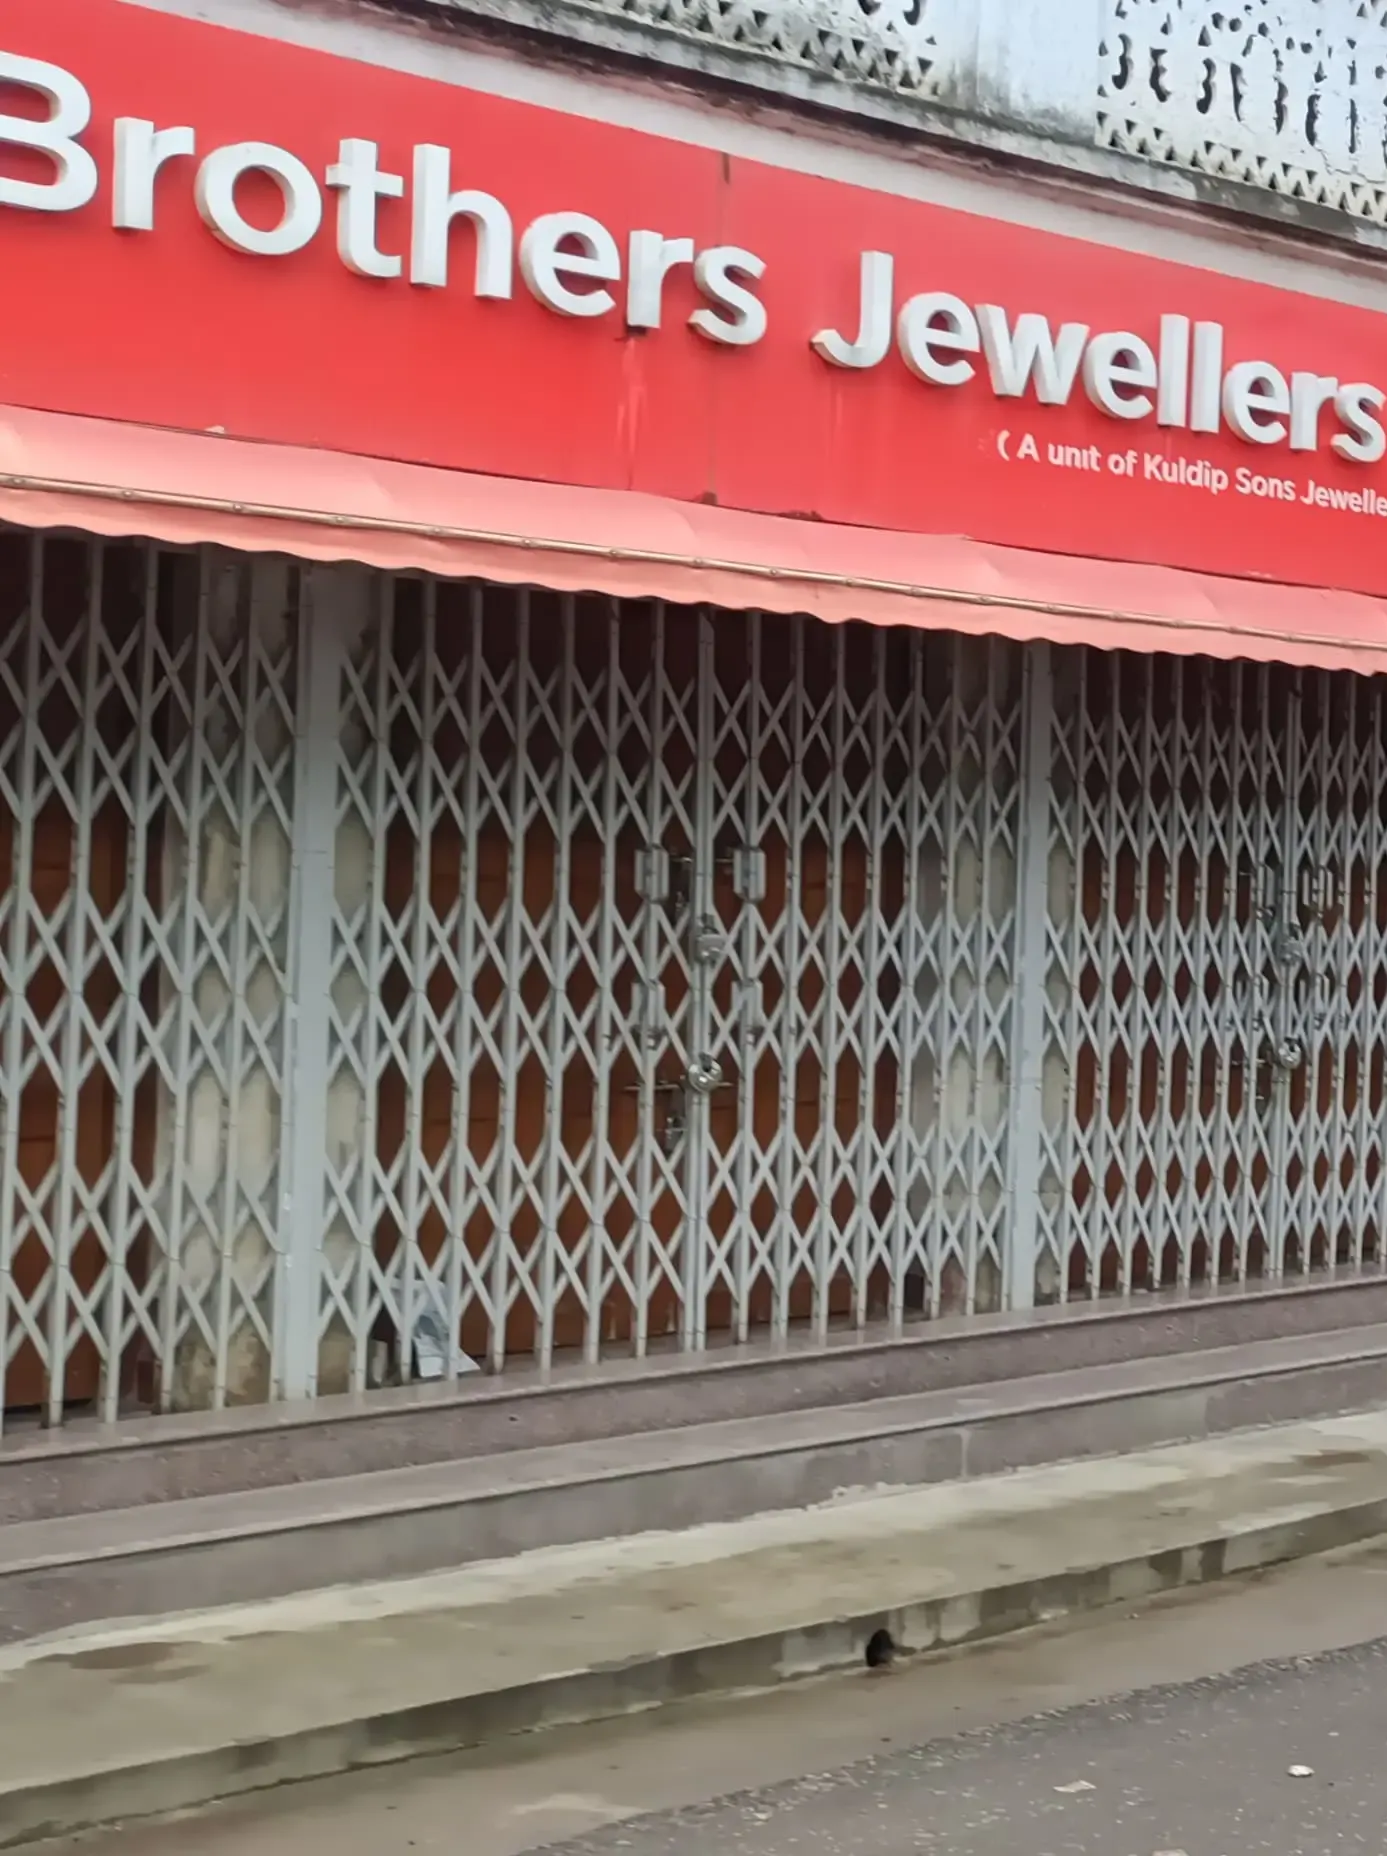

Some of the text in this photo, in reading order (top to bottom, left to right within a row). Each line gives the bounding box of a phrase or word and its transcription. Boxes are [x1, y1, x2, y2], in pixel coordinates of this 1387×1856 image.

[0, 51, 1387, 463] Brothers Jewellers
[1048, 443, 1101, 473] unit
[1108, 450, 1138, 477] of
[1144, 453, 1229, 495] Kuldip
[1235, 467, 1297, 502] Sons
